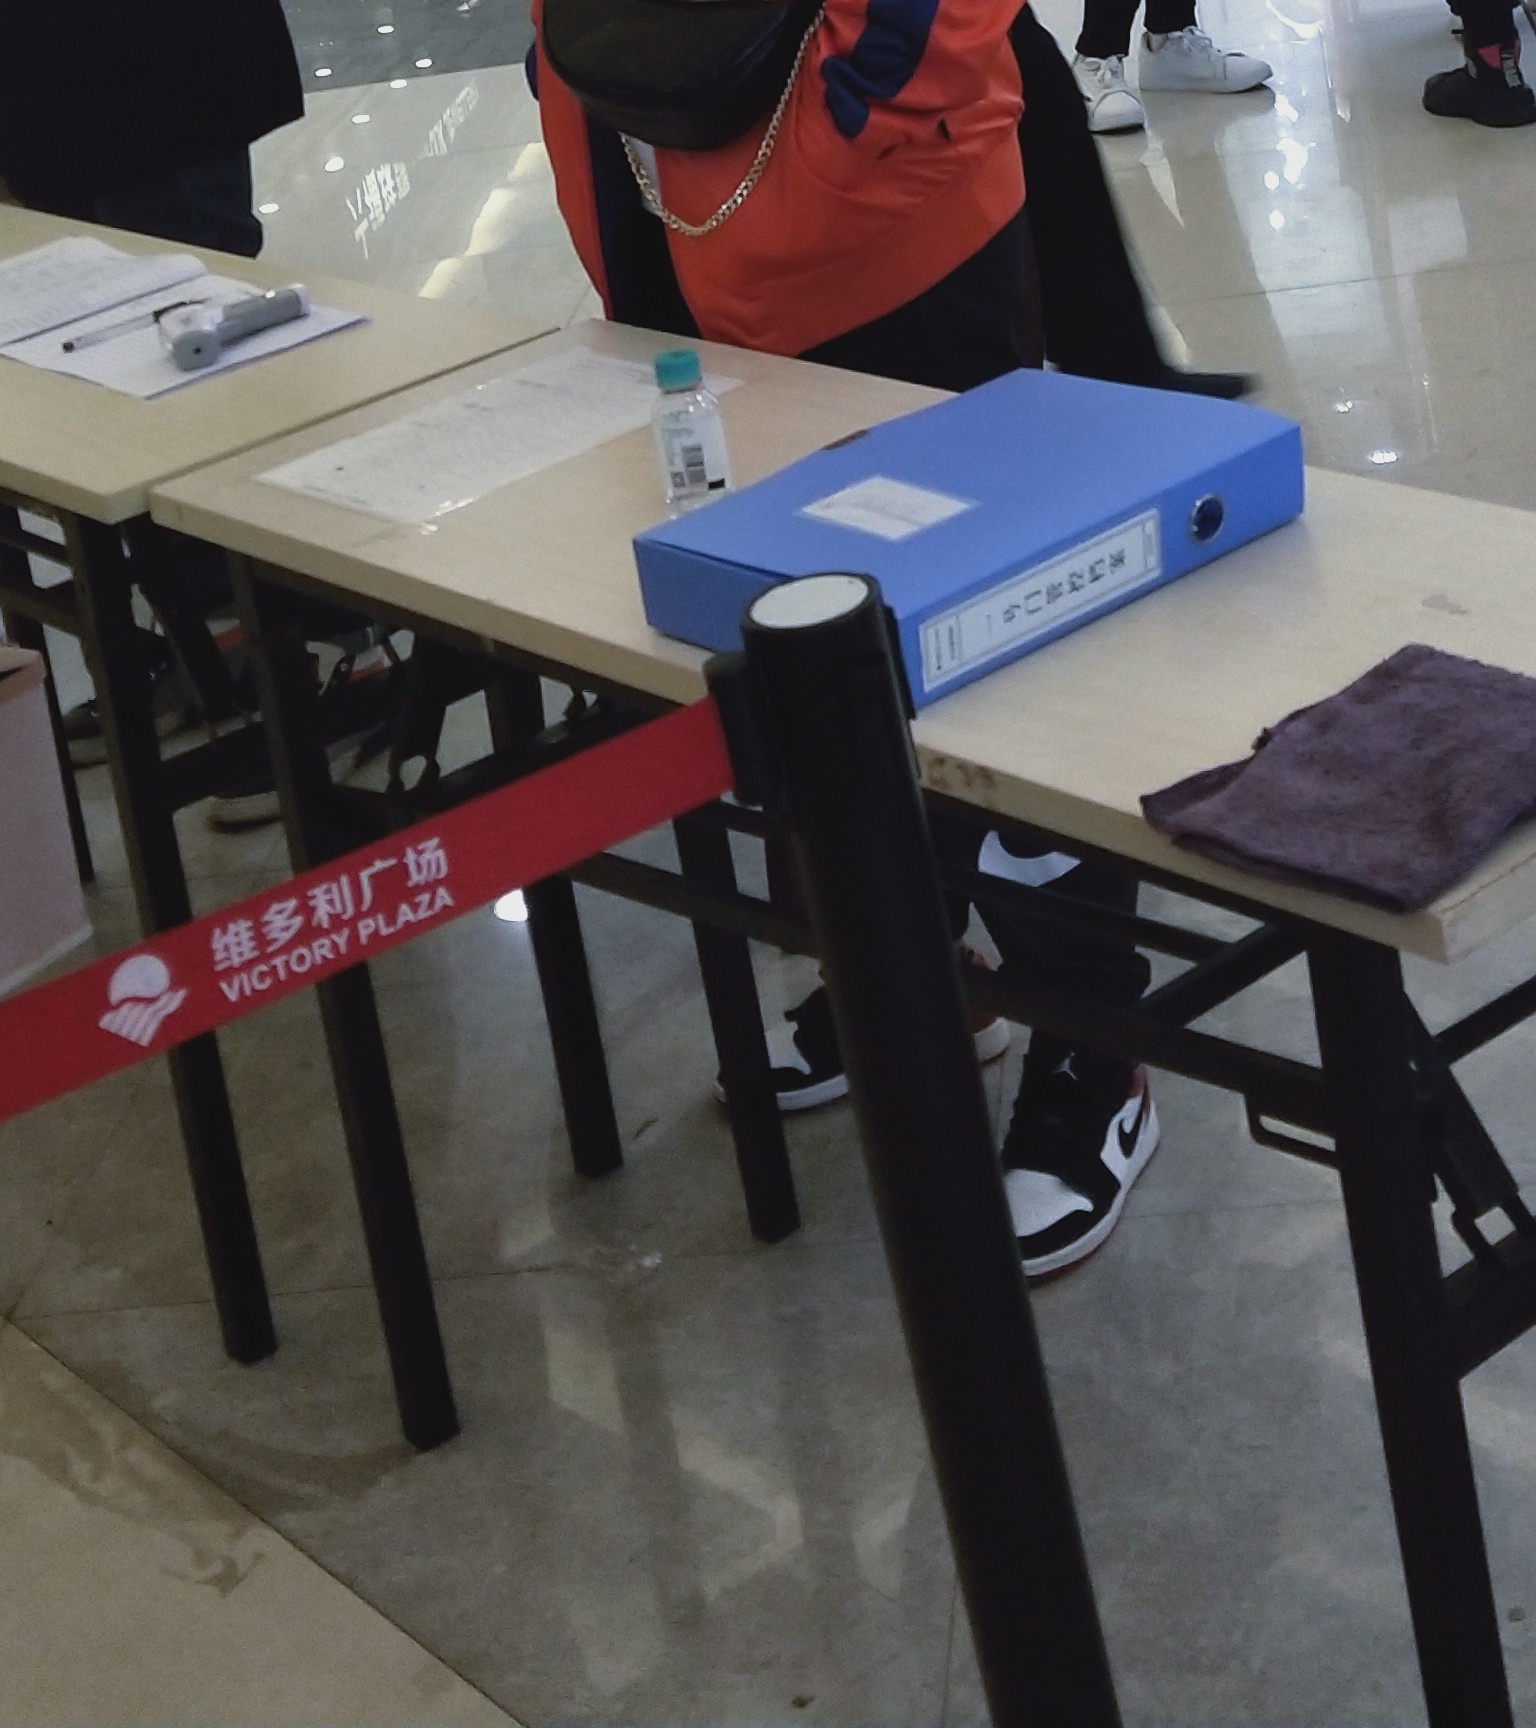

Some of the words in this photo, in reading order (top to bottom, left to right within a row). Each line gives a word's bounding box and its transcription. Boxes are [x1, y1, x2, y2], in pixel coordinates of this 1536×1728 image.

[209, 836, 449, 973] 维多利广场
[218, 932, 349, 1003] VICTORY
[357, 886, 455, 945] PLAZA
